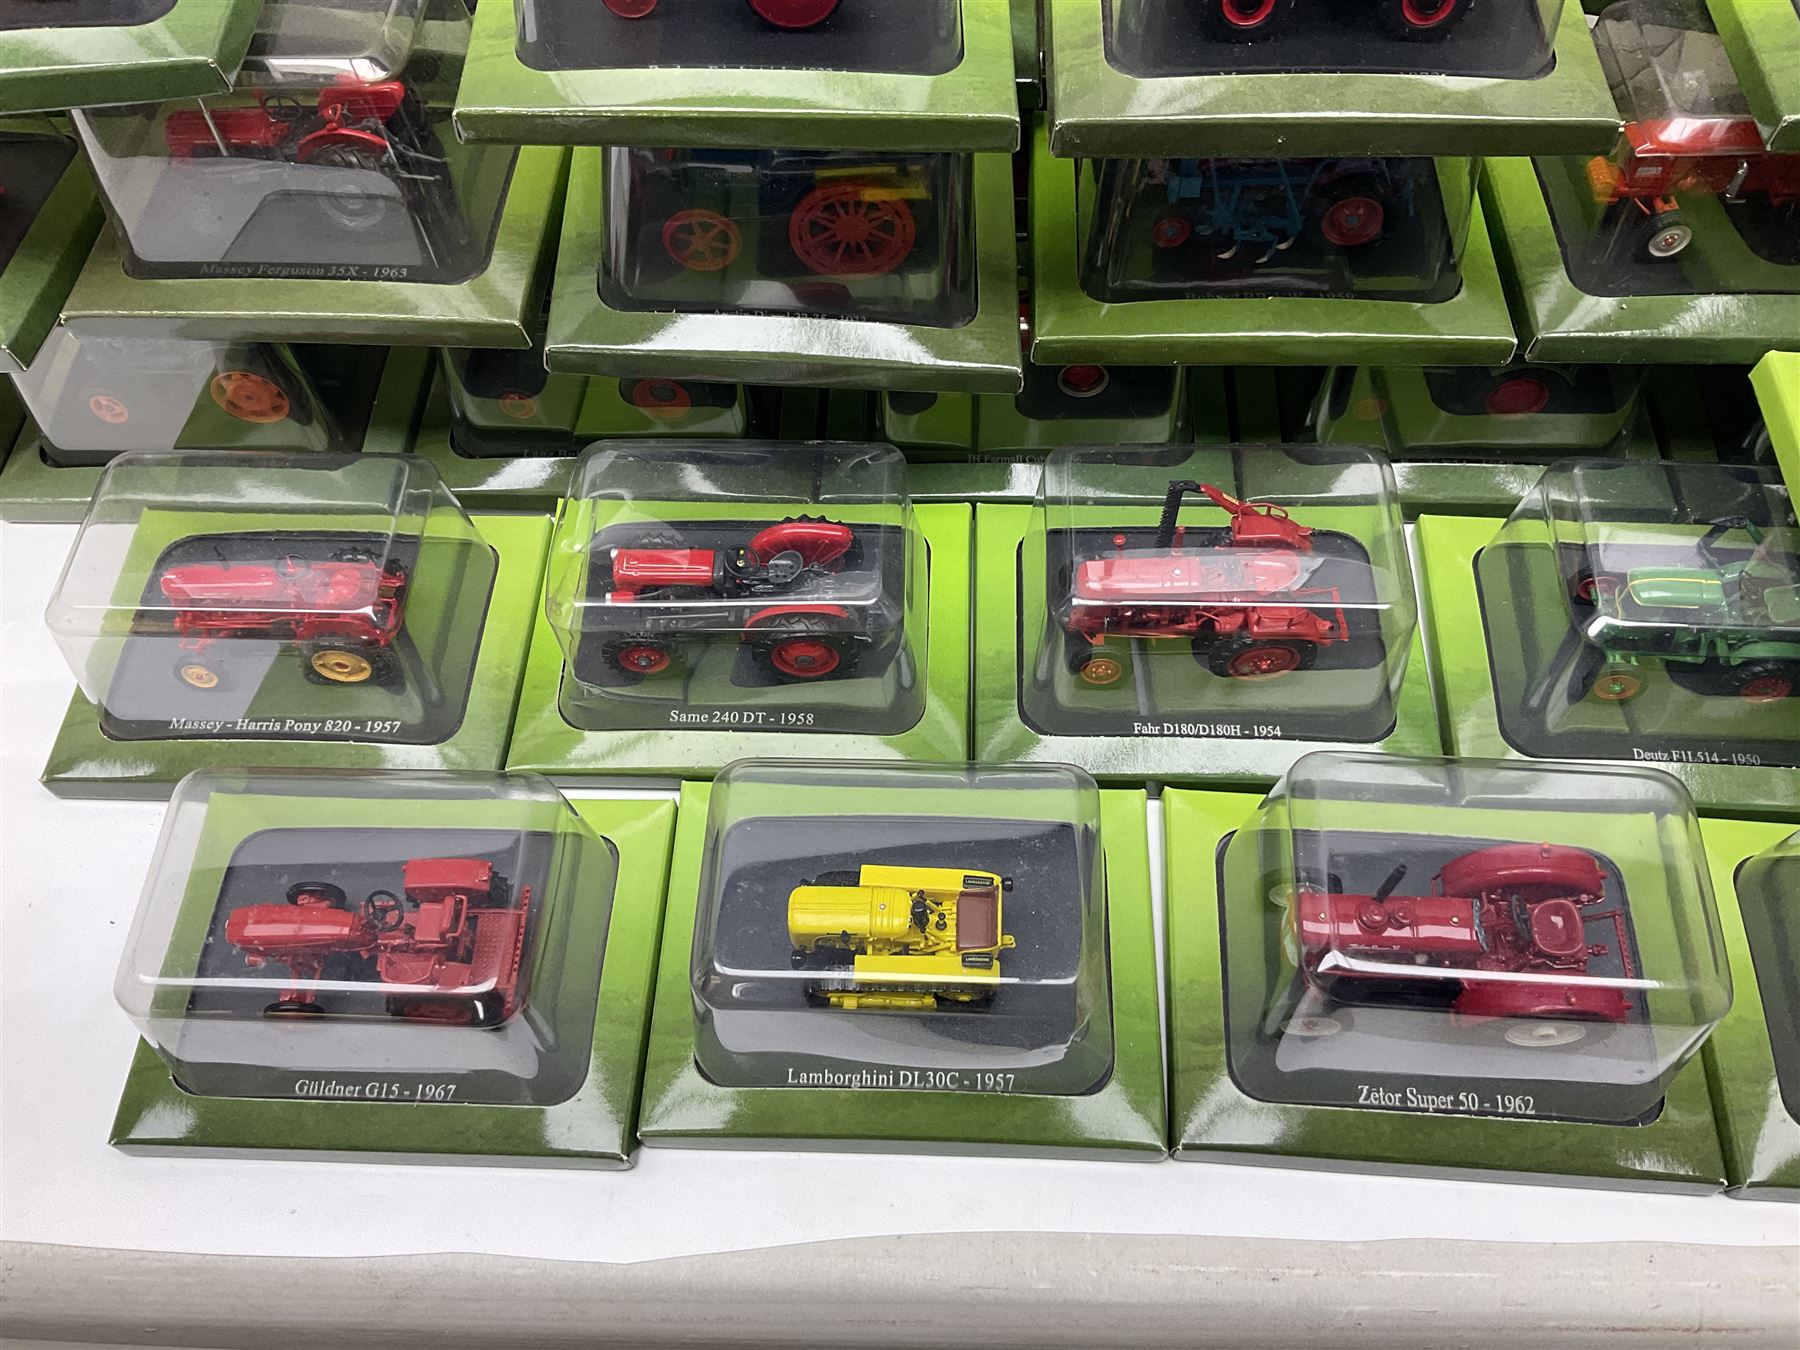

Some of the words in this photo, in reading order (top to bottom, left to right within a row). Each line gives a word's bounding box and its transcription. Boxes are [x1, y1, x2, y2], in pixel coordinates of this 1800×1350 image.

[200, 264, 253, 277] Massey
[257, 264, 324, 277] Ferguson
[328, 265, 358, 277] 35X
[169, 718, 223, 733] Massey
[236, 719, 281, 732] Harris
[285, 720, 321, 734] Pony
[324, 720, 351, 733] 820
[364, 721, 401, 733] 1957
[669, 710, 709, 723] Same
[712, 711, 739, 724] 240
[742, 712, 767, 724] DT
[781, 713, 815, 725] 1958
[1133, 722, 1161, 735] Fahr
[1163, 723, 1241, 736] D180/D180H
[1253, 725, 1281, 737] 1954
[1632, 748, 1670, 761] Deutz
[1671, 750, 1719, 764] F1L514
[1731, 753, 1761, 766] 1950
[787, 1068, 894, 1088] Lamborghini
[899, 1071, 959, 1089] DL30C
[976, 1073, 1015, 1091] 1957
[295, 1079, 362, 1098] Güldner
[365, 1082, 400, 1098] G15
[416, 1084, 457, 1100] 1967
[1406, 1087, 1454, 1112] Super
[1458, 1092, 1479, 1111] 50
[1496, 1095, 1536, 1115] 1962
